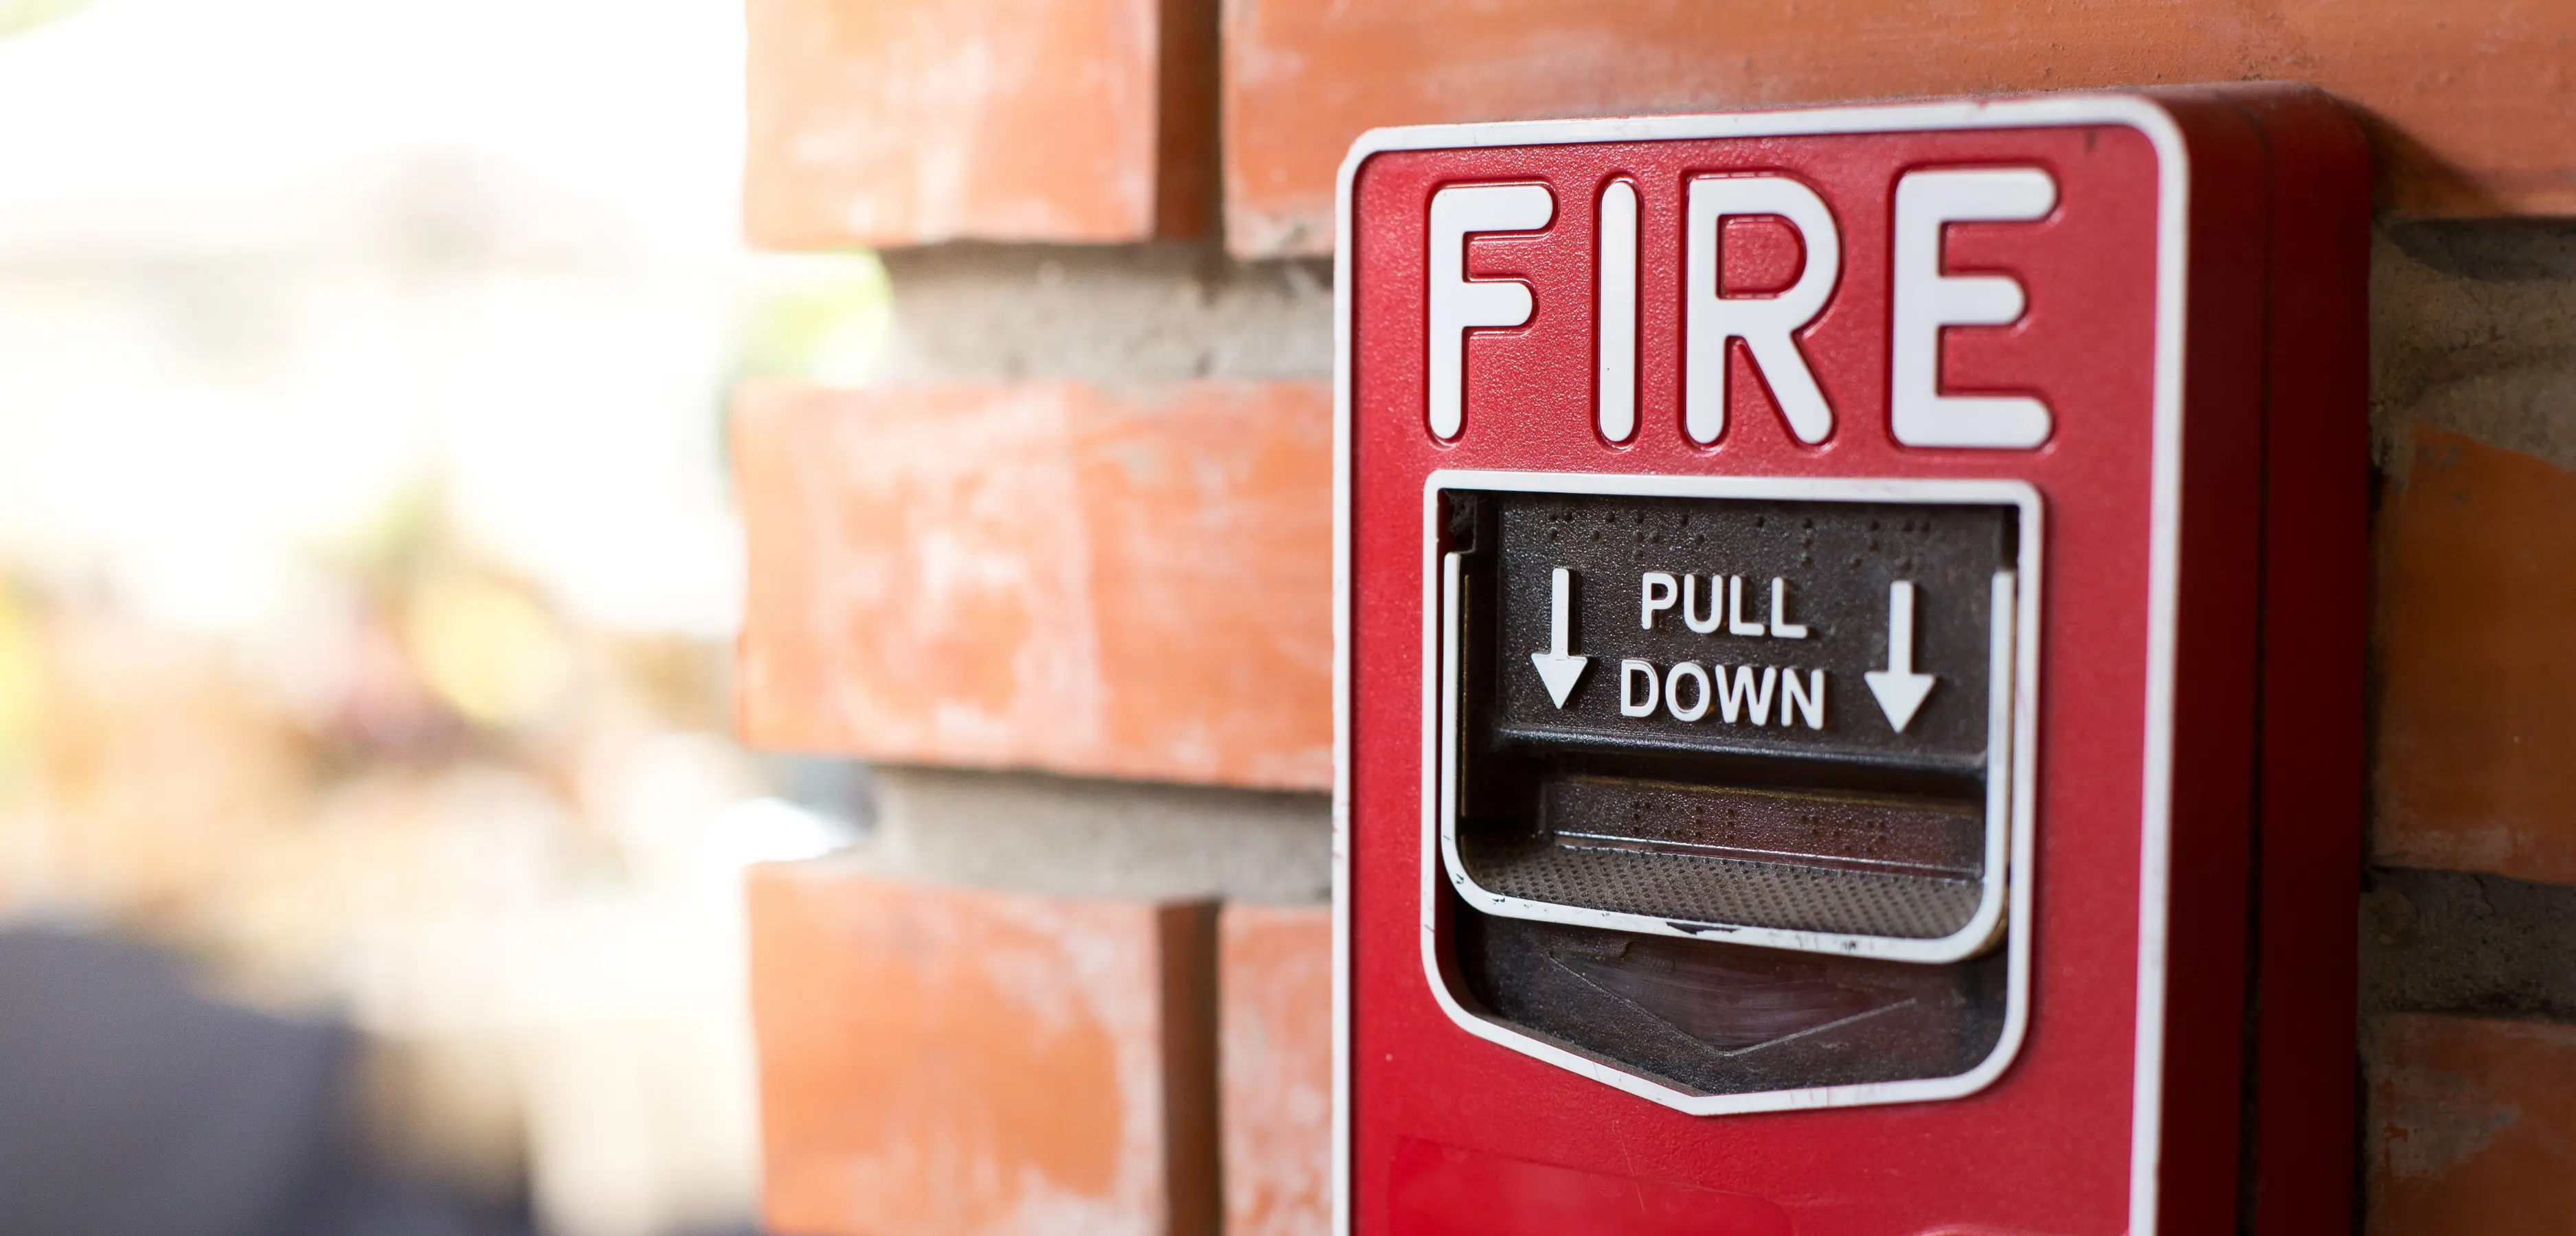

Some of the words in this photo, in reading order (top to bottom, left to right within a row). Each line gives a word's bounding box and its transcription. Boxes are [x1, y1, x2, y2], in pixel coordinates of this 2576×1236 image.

[1428, 166, 2057, 450] FIRE
[1639, 570, 1809, 639] PULL
[1618, 656, 1825, 731] DOWN
